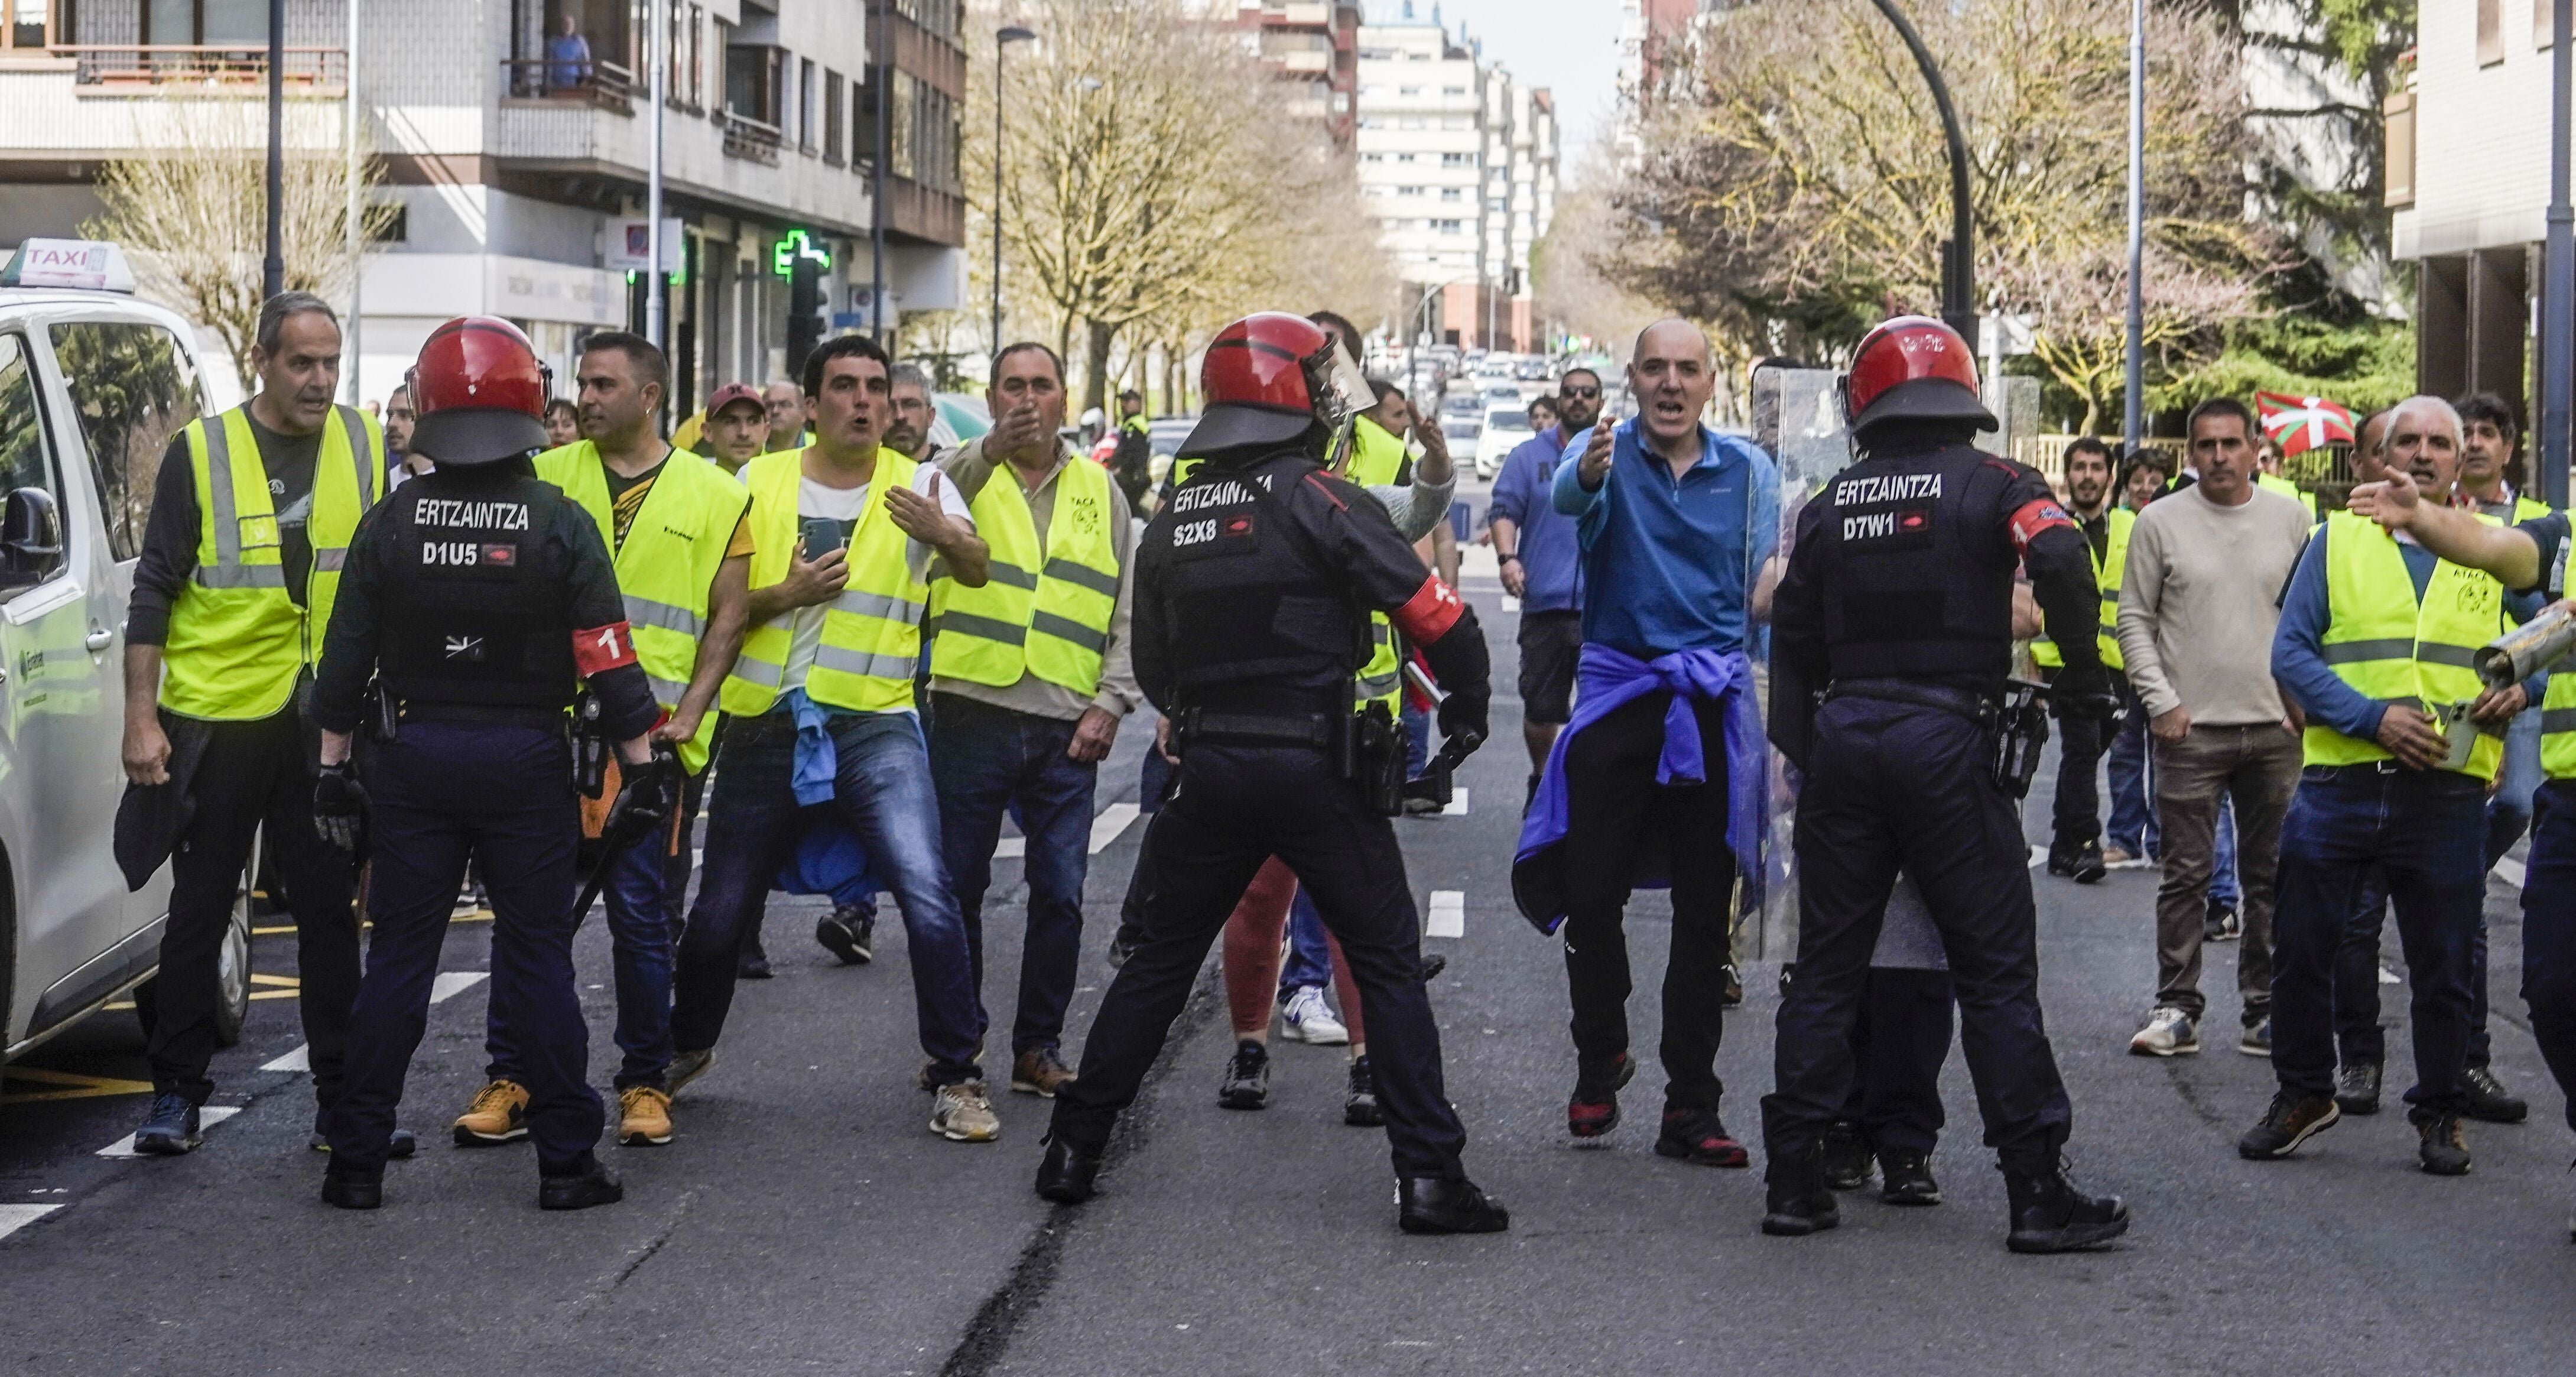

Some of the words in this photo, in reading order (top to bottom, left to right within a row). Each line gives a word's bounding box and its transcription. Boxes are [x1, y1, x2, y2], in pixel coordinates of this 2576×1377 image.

[28, 249, 87, 266] TAXI
[1834, 473, 1942, 506] ERTZAINTZA
[414, 498, 529, 531] ERTZAINTZA
[1843, 511, 1894, 541] D7W1
[1173, 518, 1217, 547] S2X8
[423, 542, 477, 566] D1U5
[597, 627, 621, 660] 1
